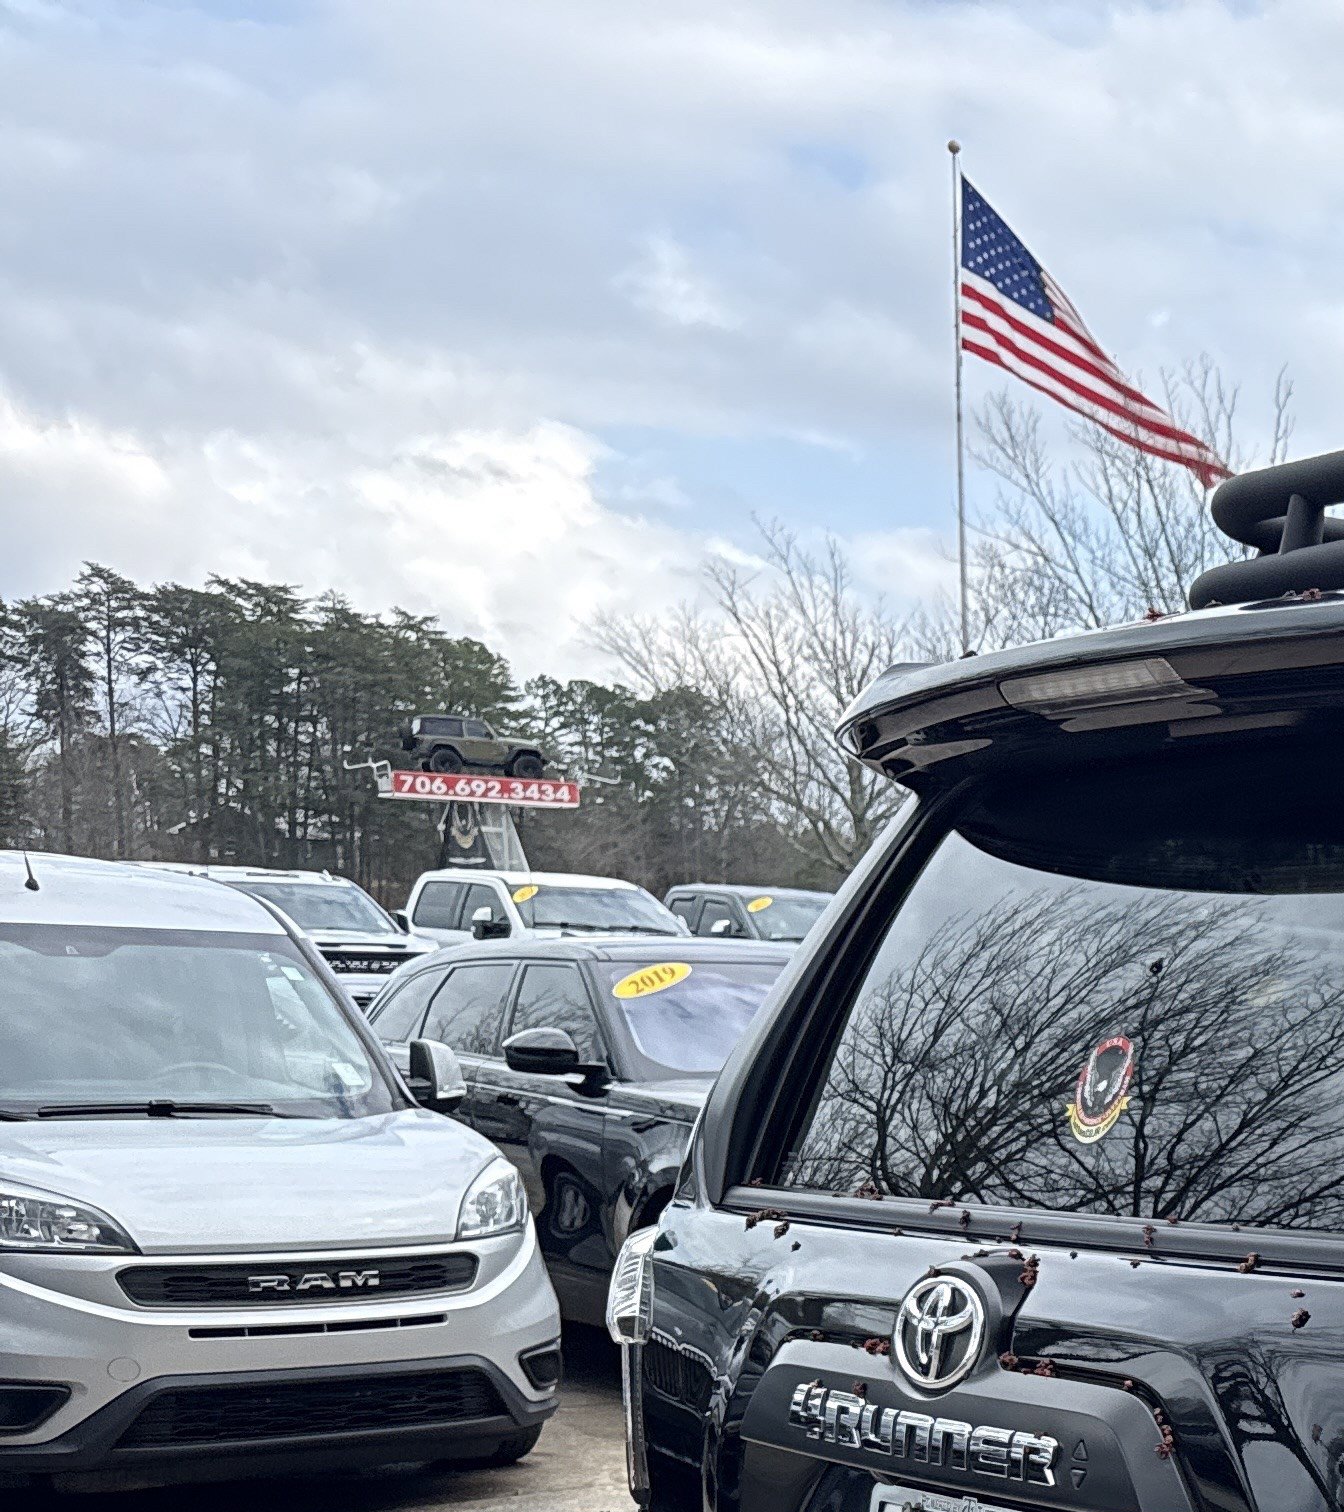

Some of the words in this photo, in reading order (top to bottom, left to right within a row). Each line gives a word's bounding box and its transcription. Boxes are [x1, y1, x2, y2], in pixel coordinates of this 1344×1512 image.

[399, 774, 571, 803] 706.692.3434
[628, 965, 677, 995] 2019
[248, 1270, 380, 1292] RAM
[788, 1383, 1058, 1486] 4RUNNER
